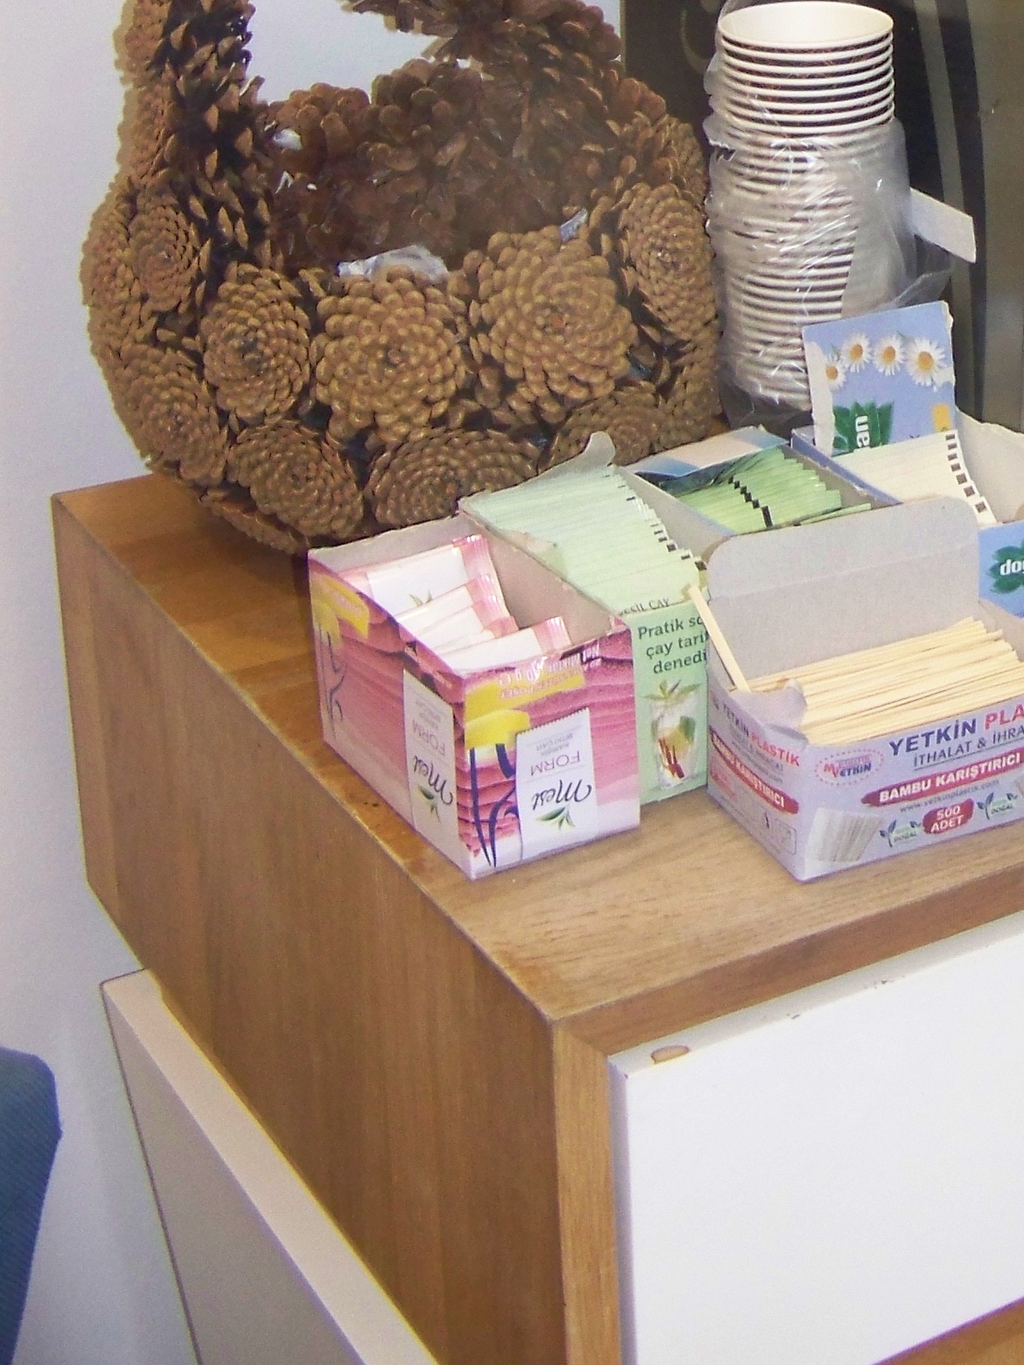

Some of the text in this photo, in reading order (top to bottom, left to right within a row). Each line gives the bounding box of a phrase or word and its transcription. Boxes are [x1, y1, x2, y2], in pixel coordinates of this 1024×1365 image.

[637, 617, 684, 640] Pratik
[646, 642, 673, 660] çay
[653, 648, 707, 674] denedi
[889, 719, 977, 756] YETKİN
[530, 750, 580, 776] FORM
[914, 740, 972, 768] İTHALAT
[977, 737, 987, 750] &
[879, 752, 1021, 803] BAMBU KARIŞTIRICI
[930, 815, 965, 834] ADET
[936, 804, 961, 821] 500
